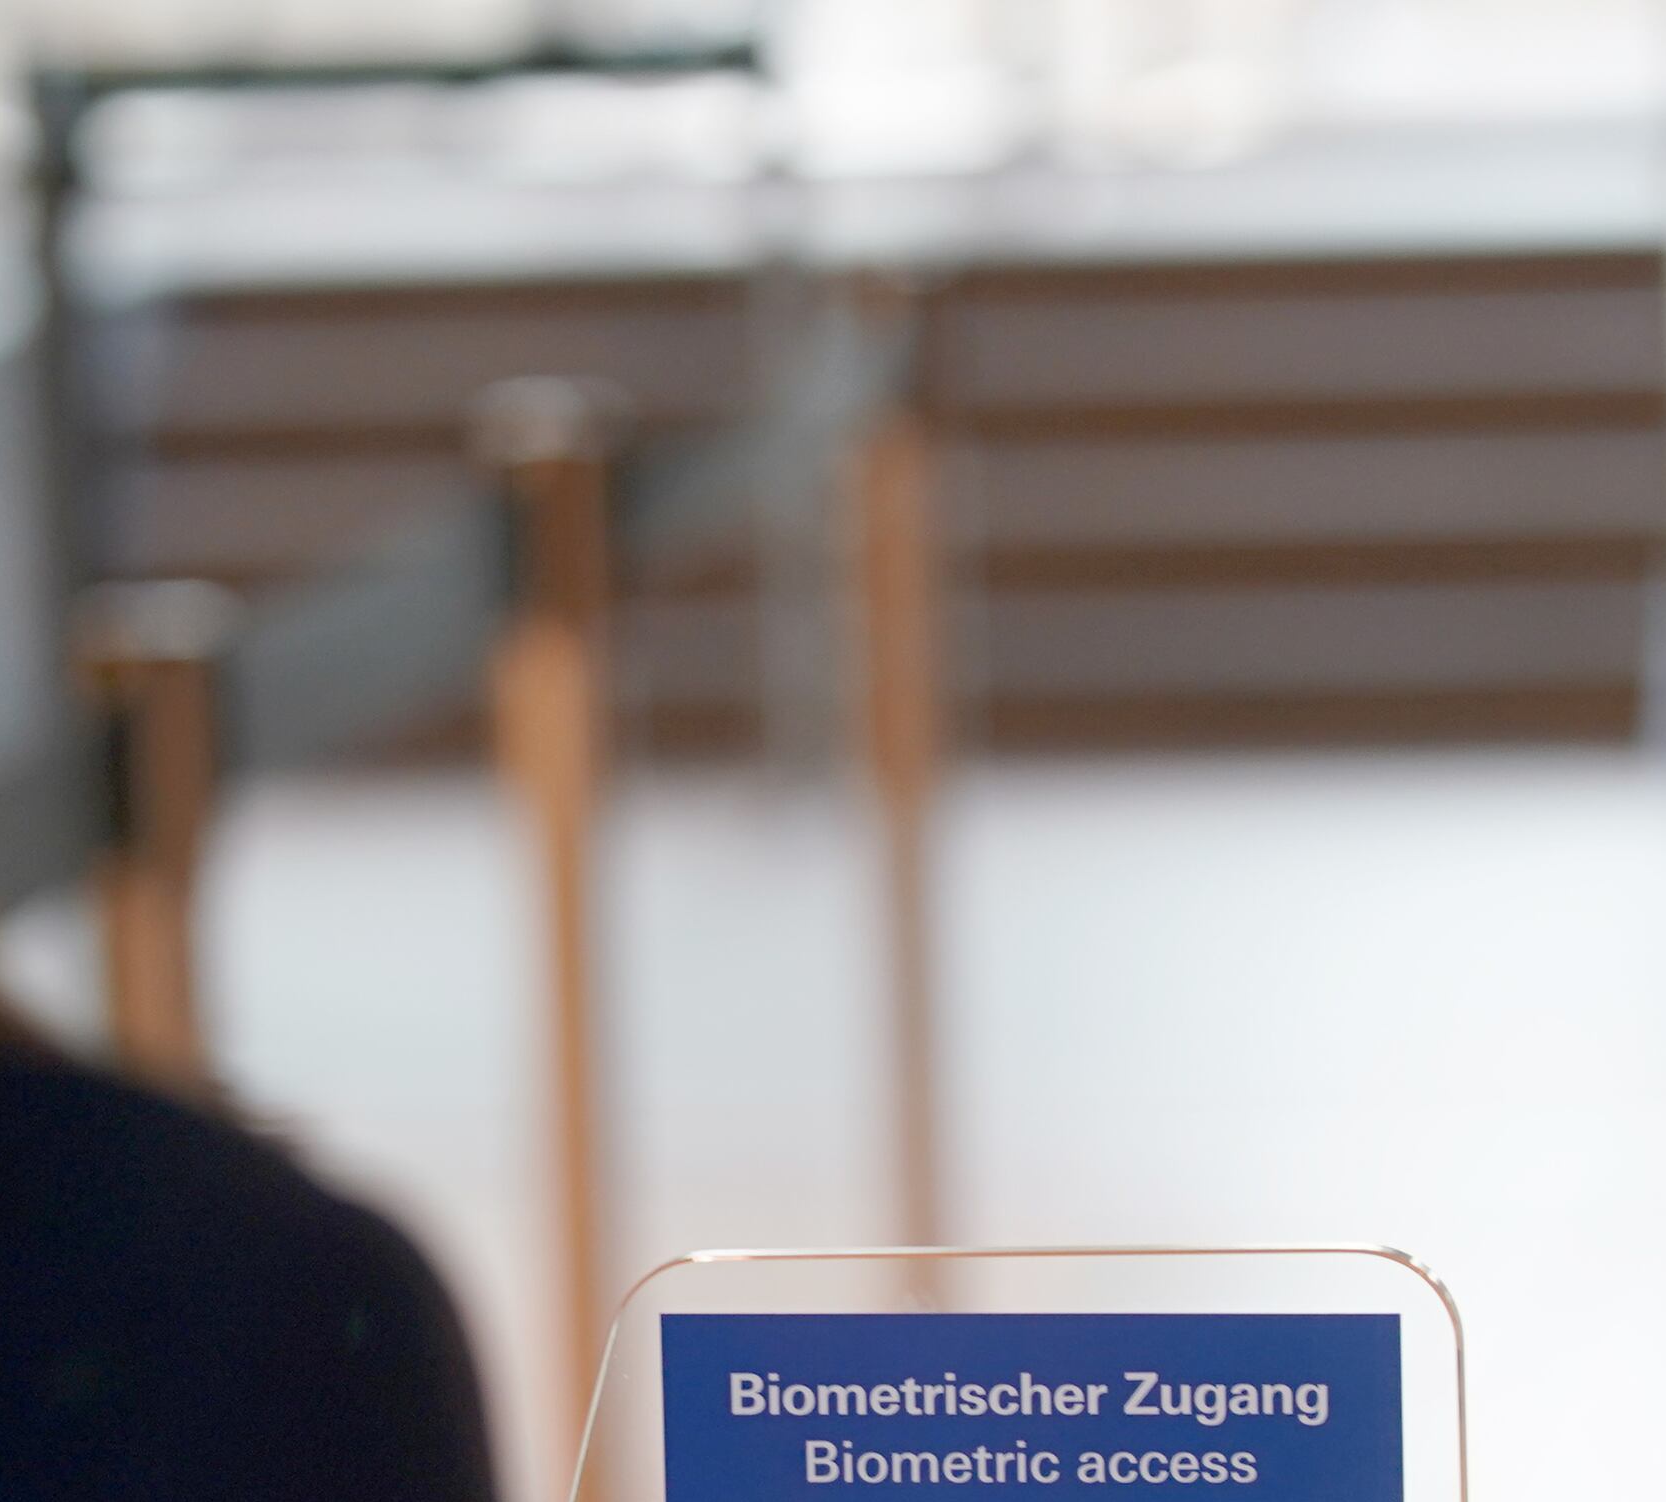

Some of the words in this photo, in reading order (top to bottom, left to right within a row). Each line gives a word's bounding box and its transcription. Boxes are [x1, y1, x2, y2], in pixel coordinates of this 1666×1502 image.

[730, 1372, 1109, 1418] Biometrischer
[1124, 1372, 1331, 1427] Zugang
[805, 1440, 1061, 1485] Biometric
[1077, 1451, 1259, 1485] access
